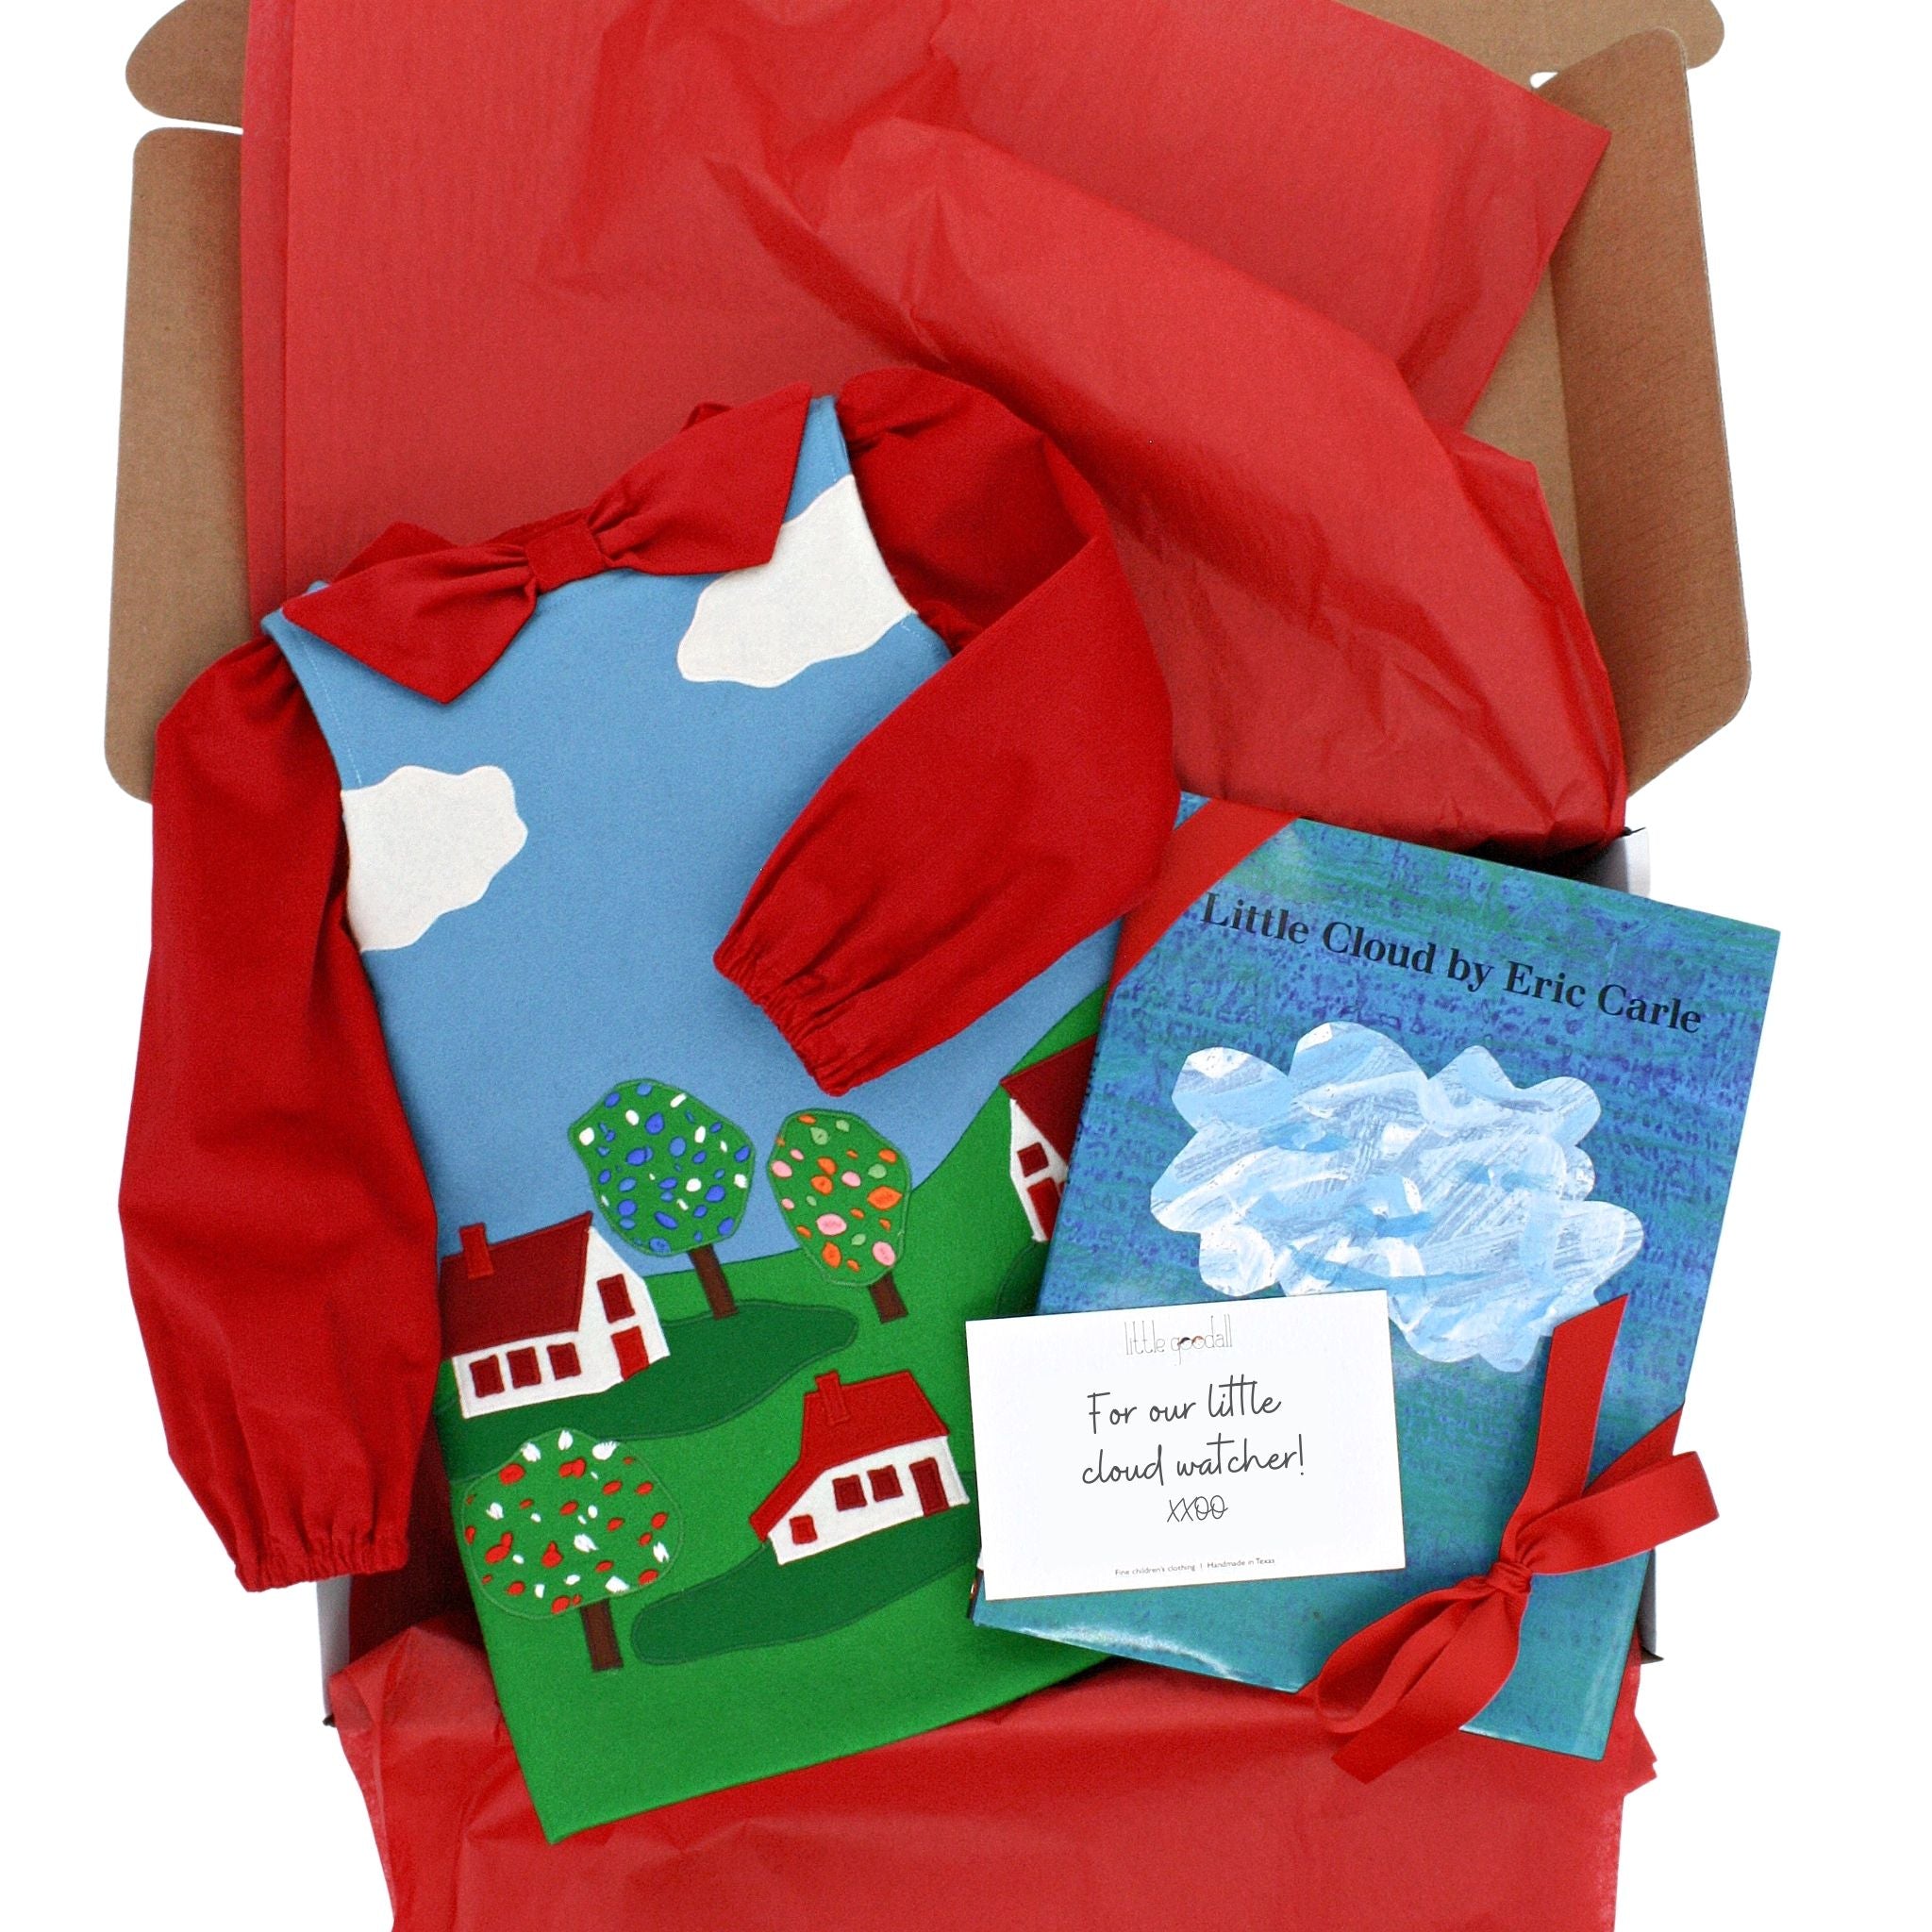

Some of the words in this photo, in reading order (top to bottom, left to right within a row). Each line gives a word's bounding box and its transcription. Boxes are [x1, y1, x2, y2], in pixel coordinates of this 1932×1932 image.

[1201, 891, 1309, 944] Little
[1322, 921, 1437, 974] Cloud
[1448, 946, 1495, 992] by
[1502, 959, 1588, 1008] Eric
[1597, 984, 1702, 1034] Carle
[1124, 1320, 1165, 1356] little
[1087, 1391, 1137, 1434] For
[1149, 1398, 1196, 1423] our
[1208, 1374, 1282, 1417] little
[1082, 1444, 1164, 1486] cloud
[1176, 1433, 1305, 1476] watcher!
[1132, 1566, 1165, 1574] children's
[1168, 1563, 1196, 1573] clothing
[1208, 1559, 1246, 1569] Handmade
[1256, 1557, 1275, 1565] Texas
